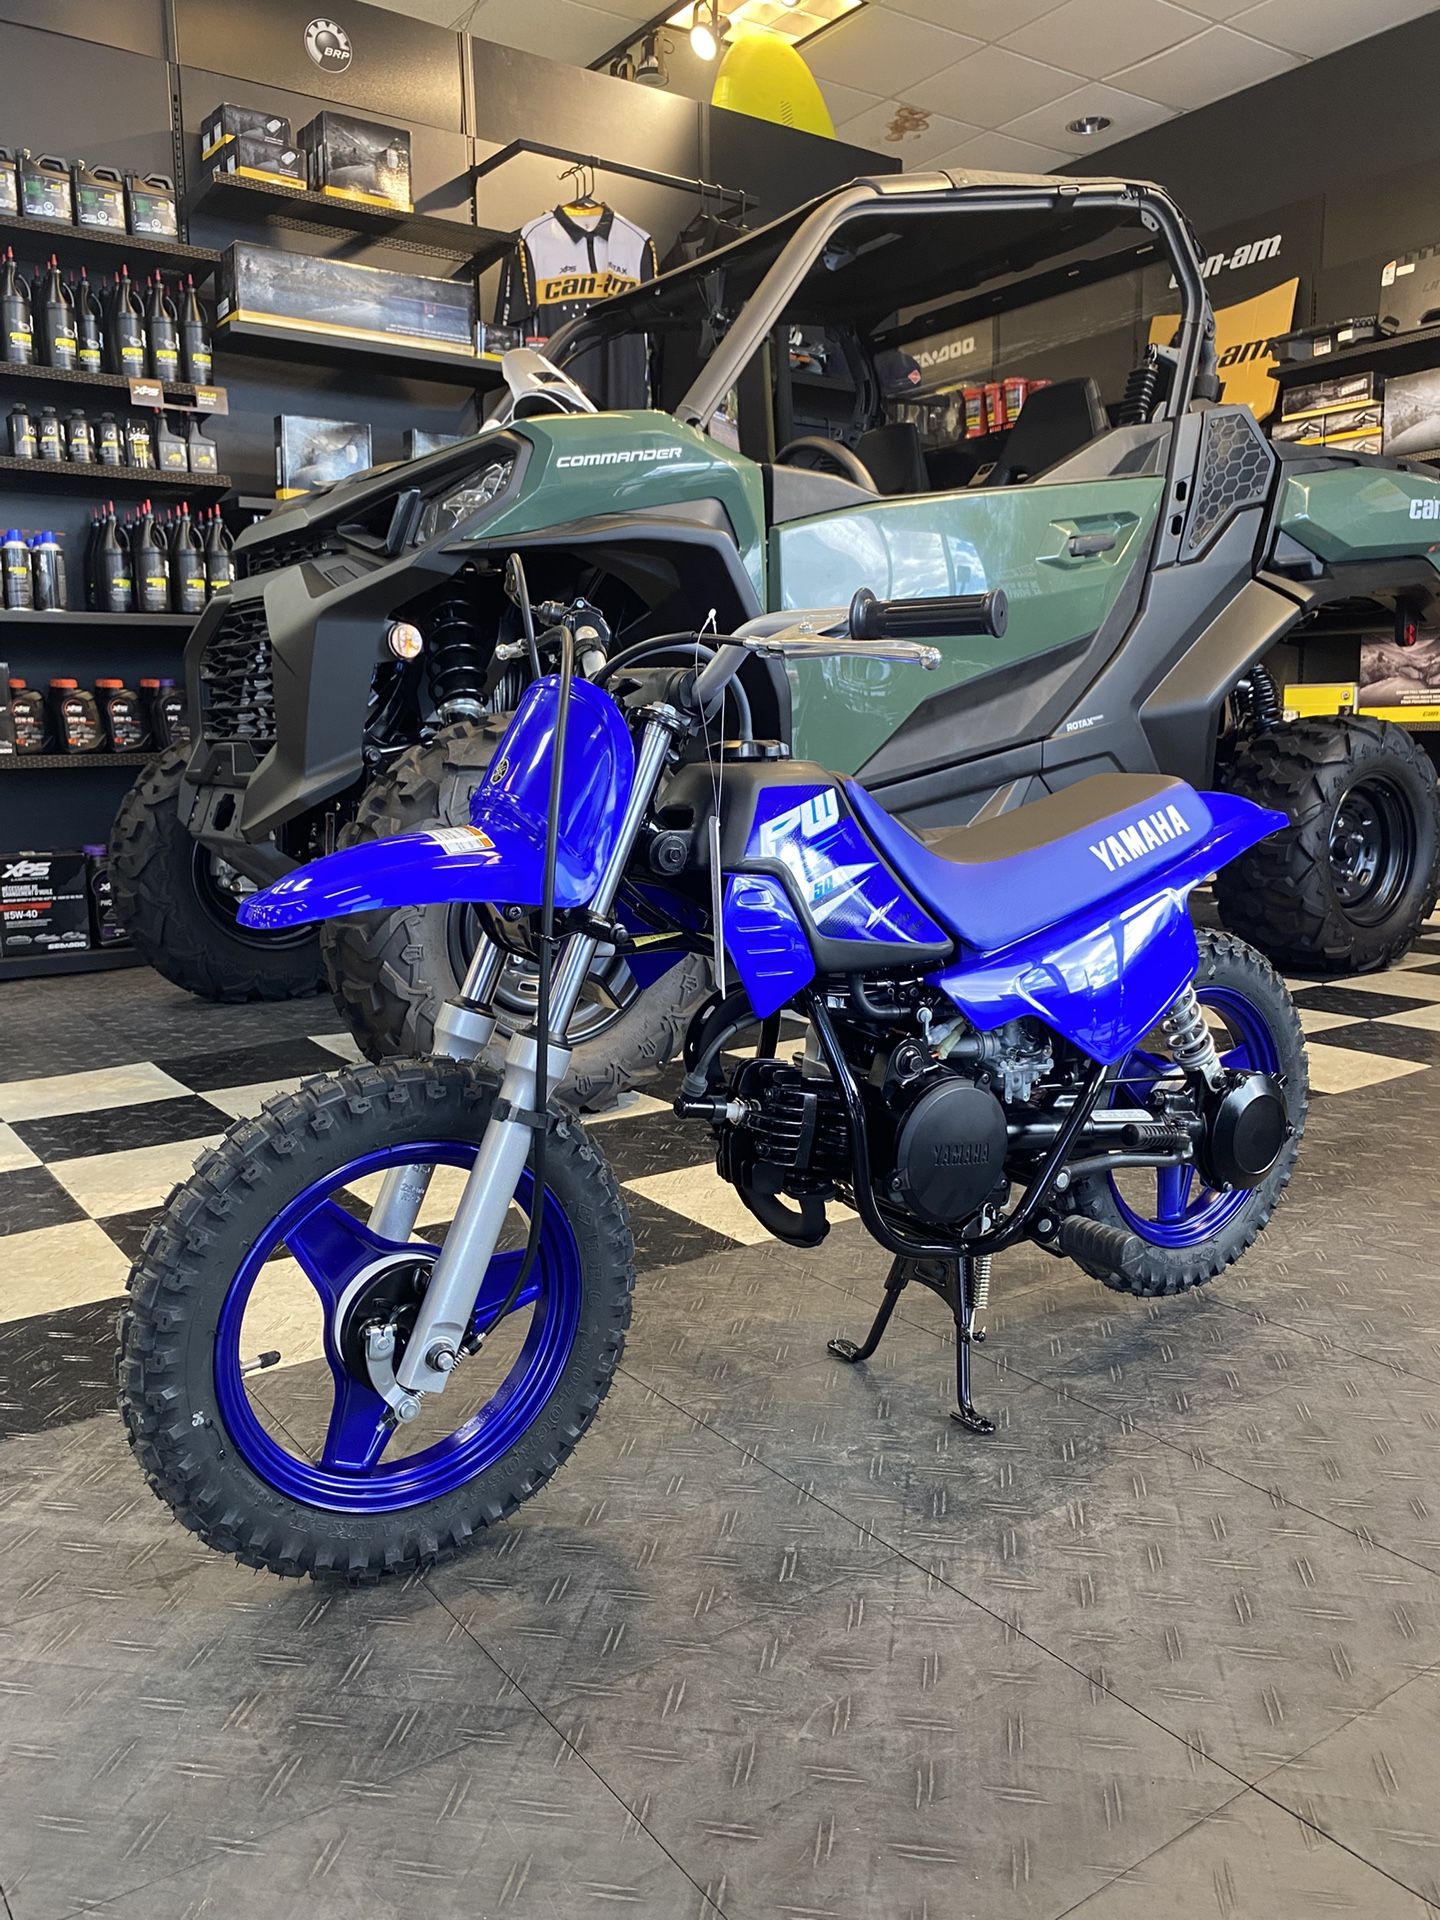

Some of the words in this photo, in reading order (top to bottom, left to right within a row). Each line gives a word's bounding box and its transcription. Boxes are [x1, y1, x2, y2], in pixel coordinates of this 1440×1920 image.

[324, 46, 350, 60] BRP
[560, 265, 577, 273] XPS
[133, 386, 159, 396] XPS
[556, 447, 683, 468] COMMANDER
[1066, 717, 1095, 732] ROTAX
[1088, 804, 1191, 872] YAMAHA
[1, 860, 52, 878] XPS
[814, 875, 835, 900] 50
[10, 909, 38, 920] 5W-40
[934, 1143, 990, 1167] YAMAHA
